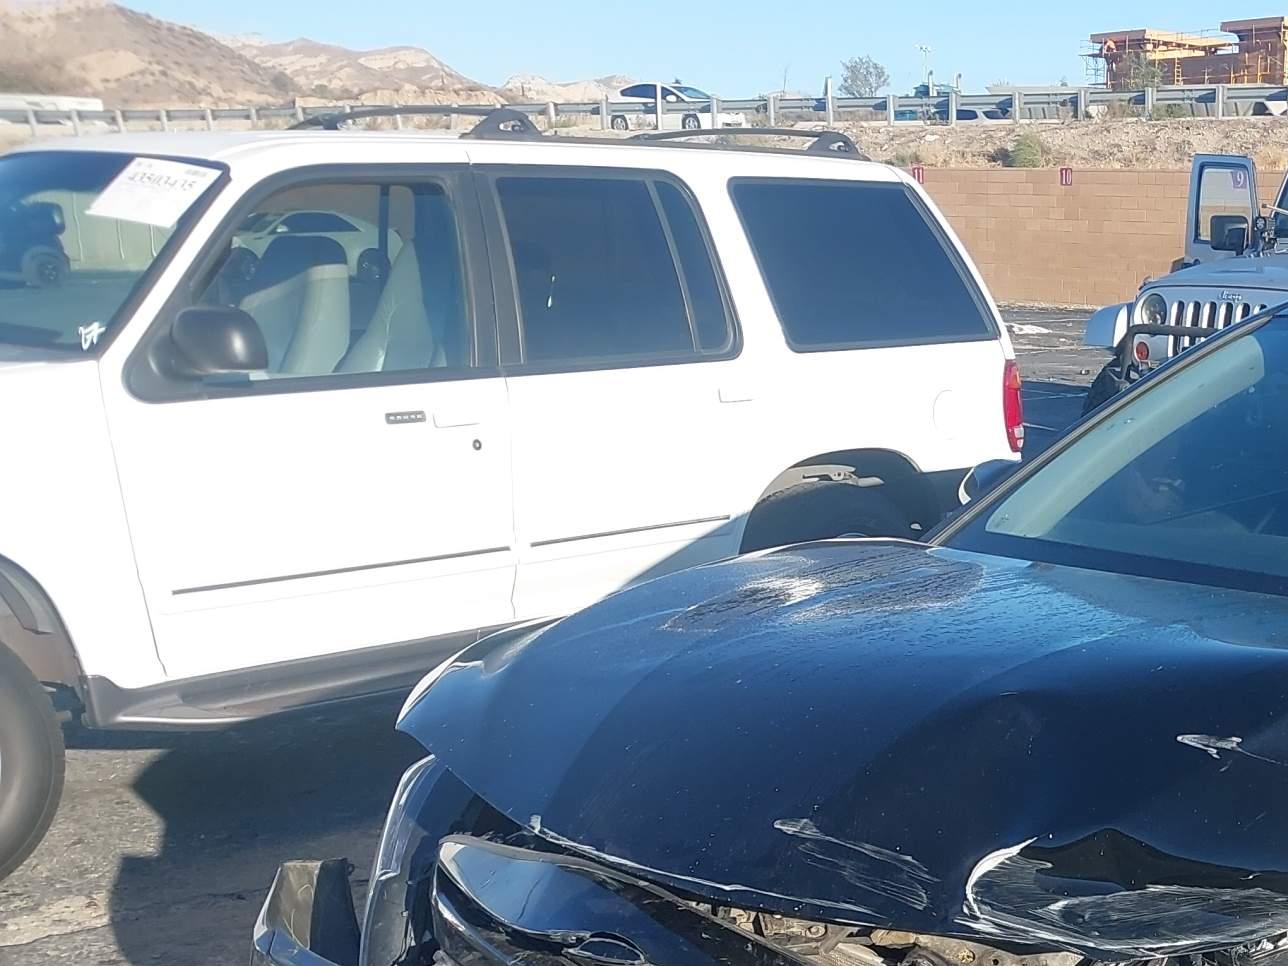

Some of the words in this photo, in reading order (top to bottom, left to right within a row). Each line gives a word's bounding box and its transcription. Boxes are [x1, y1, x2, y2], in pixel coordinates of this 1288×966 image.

[914, 168, 923, 184] 11
[1062, 168, 1072, 185] 10
[1236, 170, 1245, 187] 9
